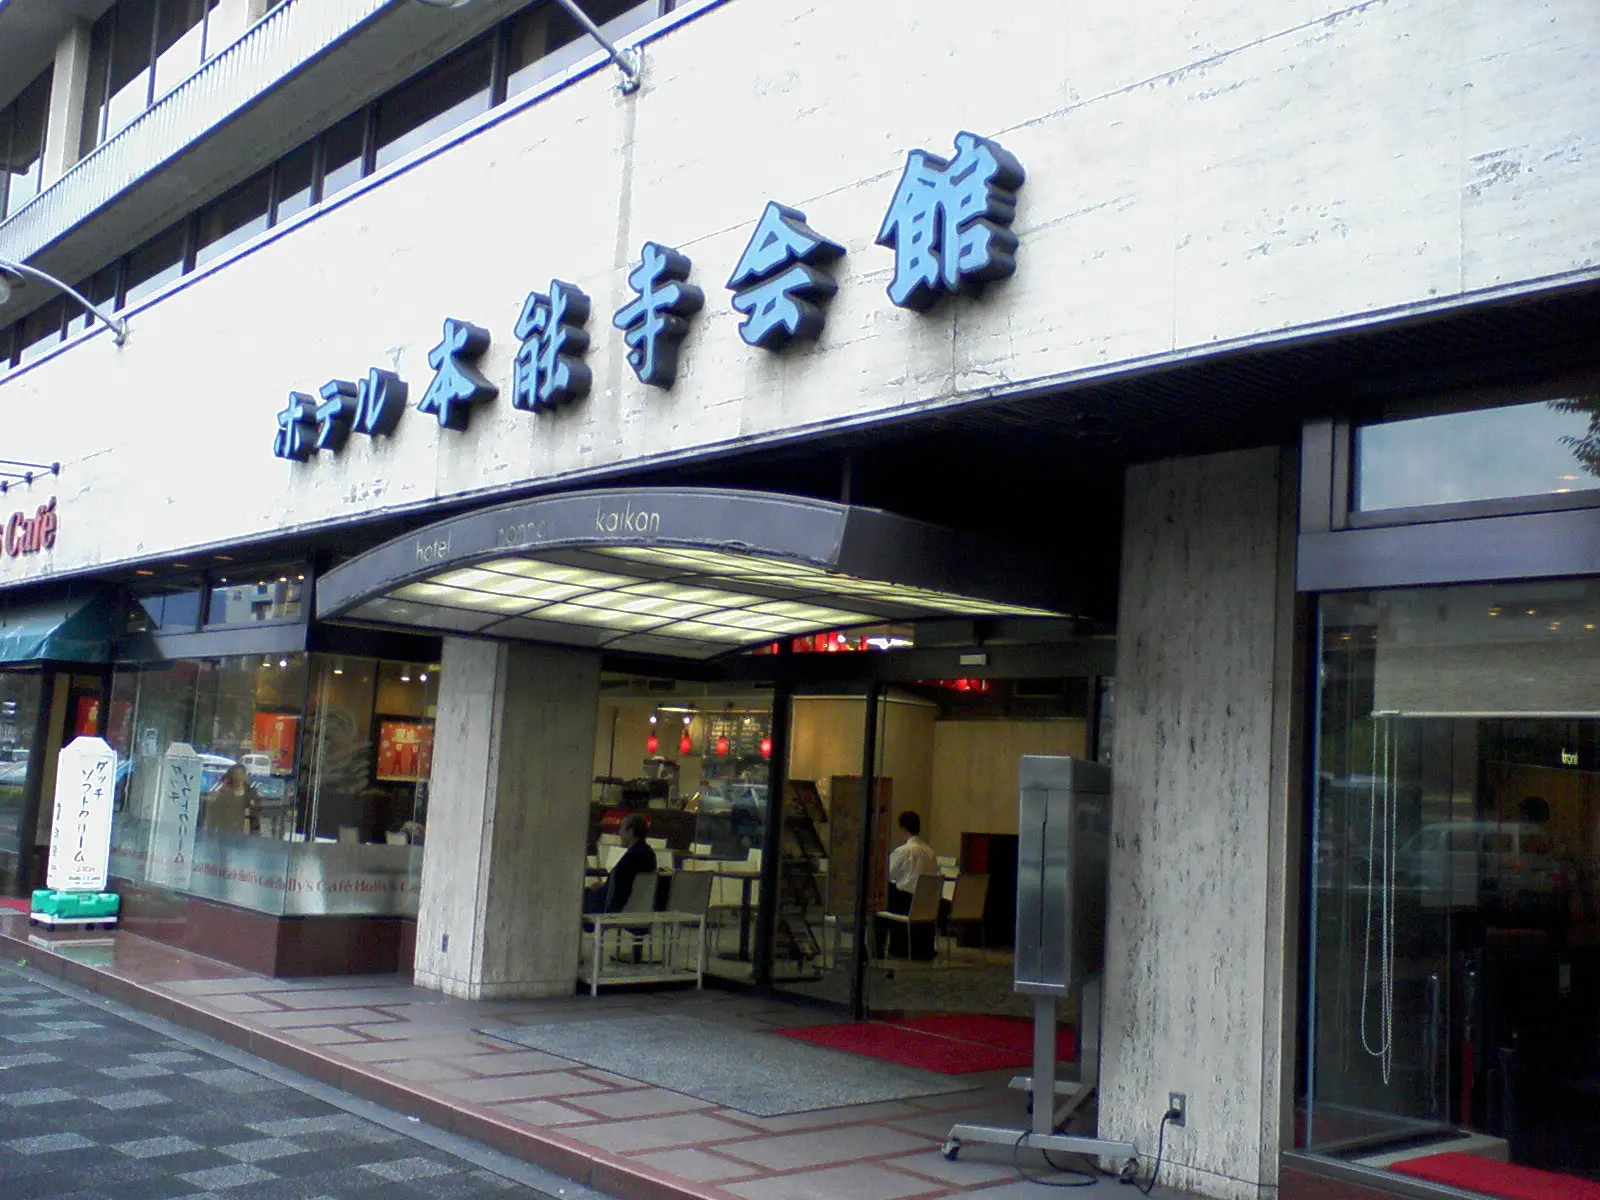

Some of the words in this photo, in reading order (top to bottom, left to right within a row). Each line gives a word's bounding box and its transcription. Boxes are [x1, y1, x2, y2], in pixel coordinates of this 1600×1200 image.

[5, 496, 58, 557] Café
[416, 531, 452, 563] hotel
[595, 499, 661, 533] kaikan
[73, 769, 94, 862] ソフトクリーム
